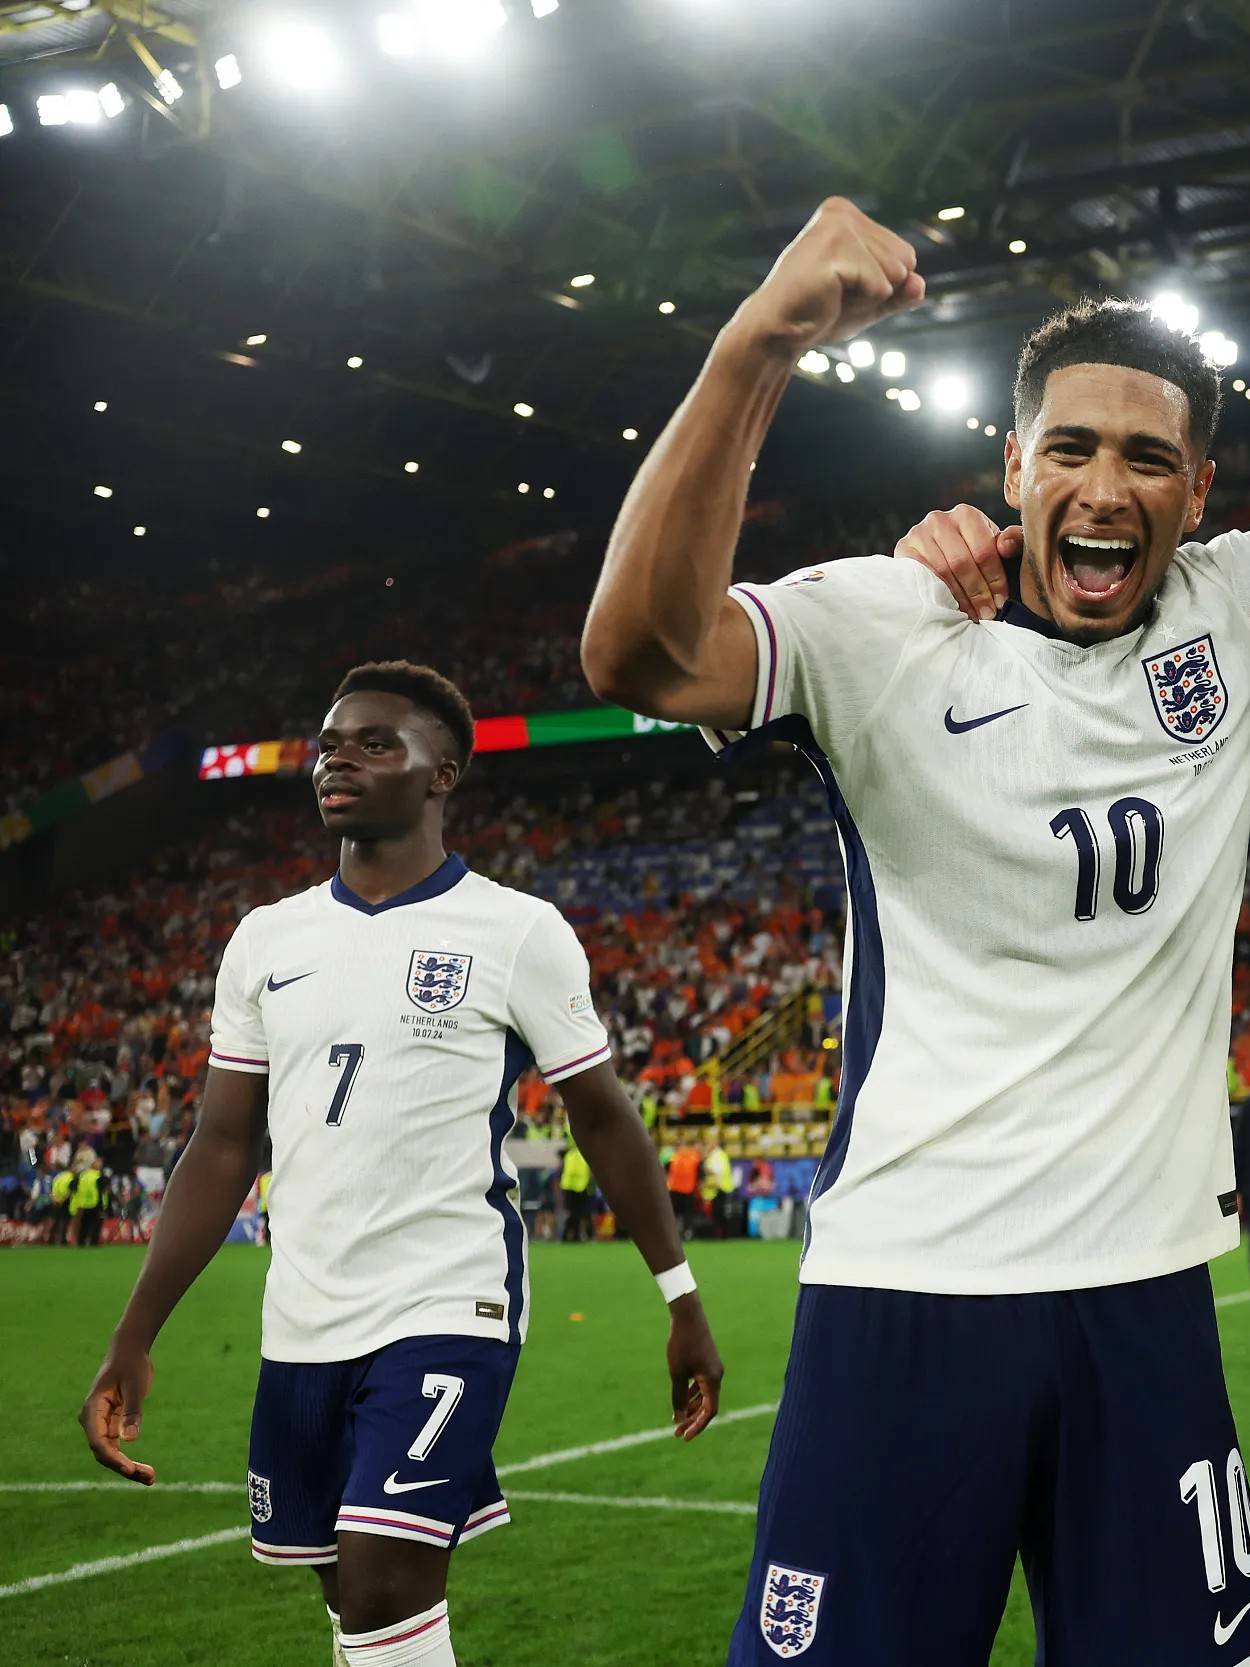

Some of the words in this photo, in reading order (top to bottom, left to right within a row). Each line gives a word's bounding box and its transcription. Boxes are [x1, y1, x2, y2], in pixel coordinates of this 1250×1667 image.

[1049, 797, 1164, 921] 10
[400, 1014, 459, 1029] NETHERLANDS
[412, 1027, 443, 1039] 10.07.24
[326, 1043, 365, 1126] 7
[407, 1373, 464, 1461] 7
